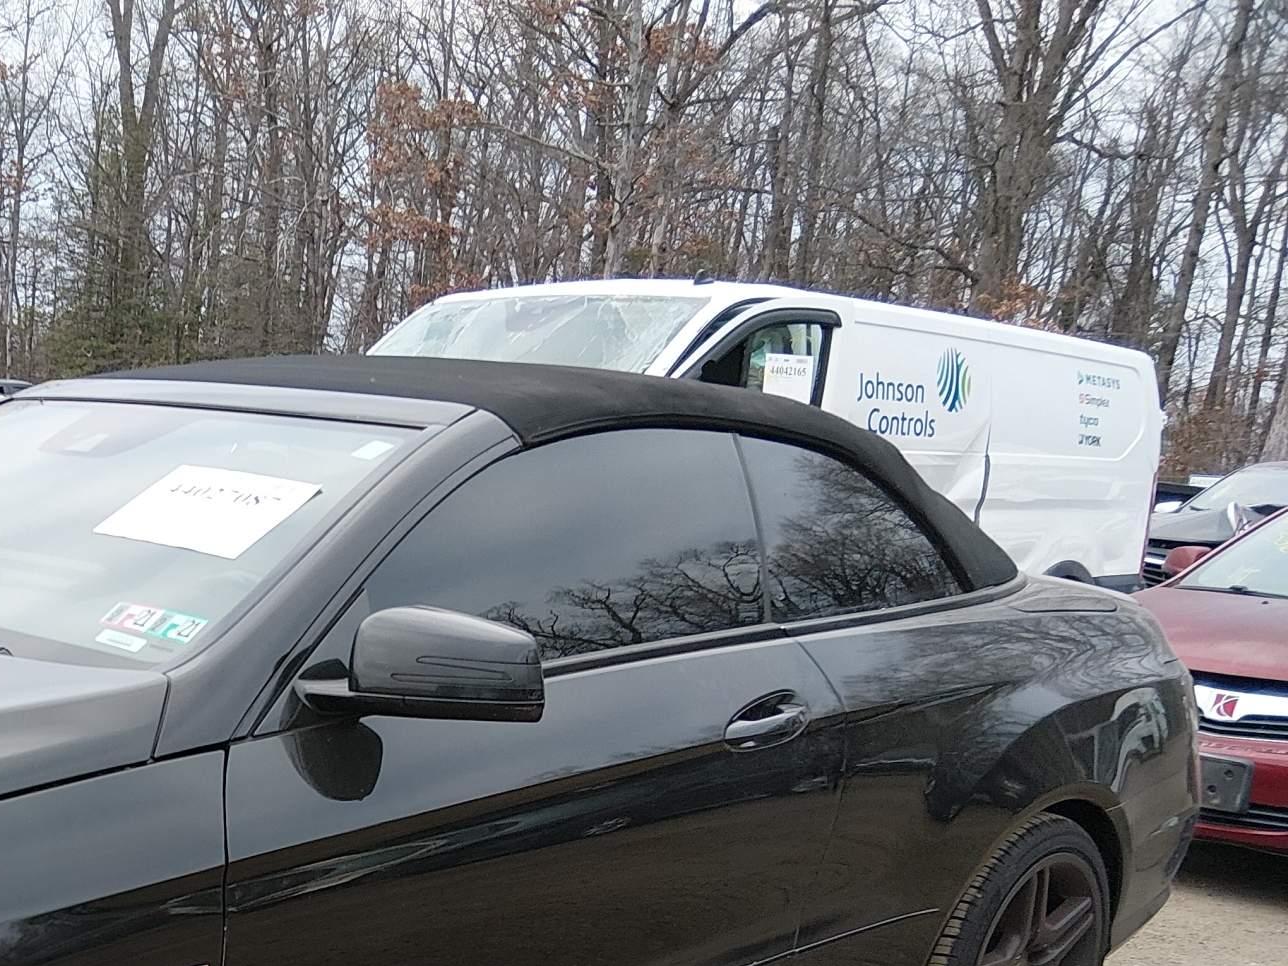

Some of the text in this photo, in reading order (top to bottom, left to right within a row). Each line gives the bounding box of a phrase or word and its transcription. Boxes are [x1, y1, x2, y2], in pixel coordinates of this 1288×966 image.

[857, 372, 925, 403] Johnson
[1085, 373, 1121, 390] METASYS
[868, 408, 935, 438] Controls
